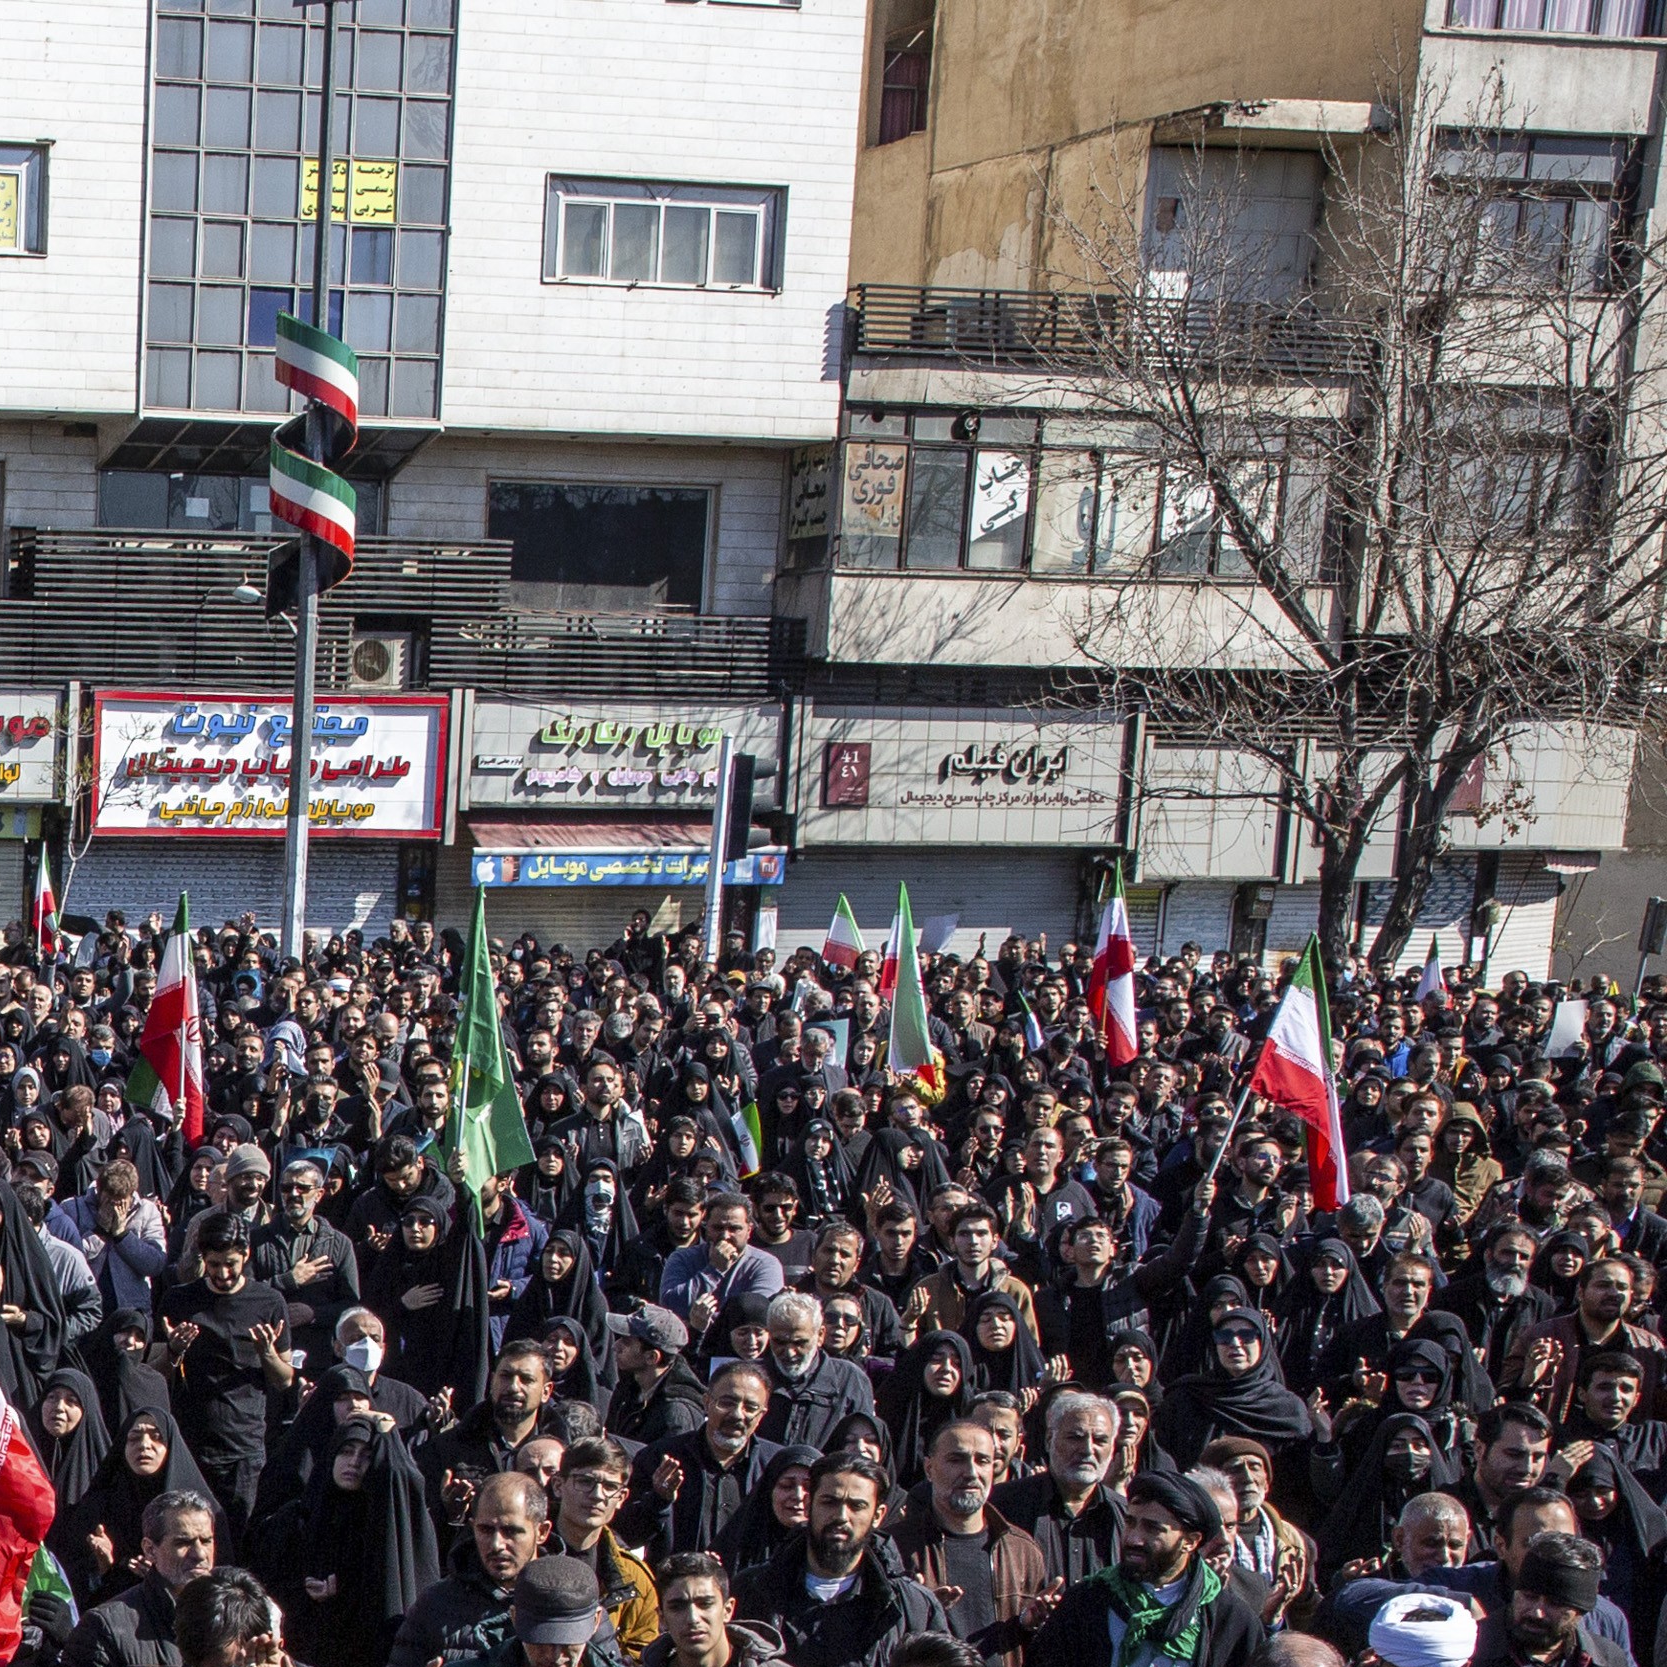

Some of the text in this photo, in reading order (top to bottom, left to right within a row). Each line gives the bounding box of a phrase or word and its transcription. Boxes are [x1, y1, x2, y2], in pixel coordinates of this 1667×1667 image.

[356, 163, 395, 179] ترجمه
[356, 186, 394, 197] رسمی
[354, 204, 393, 217] عربی
[849, 445, 905, 480] صحافی
[852, 474, 897, 505] فوری
[979, 461, 1023, 498] چاپ
[172, 704, 369, 748] مجتع نبوت
[540, 714, 723, 758] موبایل رنگارنگ
[125, 747, 238, 784] دیجیتال
[321, 754, 411, 781] طراحی
[840, 750, 861, 764] 41
[947, 742, 1070, 779] ایران فیلم
[526, 765, 583, 788] کامپیوتر
[590, 771, 600, 786] و
[607, 767, 654, 787] موبایل
[660, 768, 700, 786] جانبی
[899, 790, 944, 806] دیجیتال
[944, 792, 975, 808] سریع
[974, 791, 996, 808] چاپ
[1071, 788, 1105, 806] عکاسی
[159, 795, 376, 825] موبایل لوازم جانبی
[527, 854, 589, 882] موبایل
[589, 852, 665, 883] تخصصی
